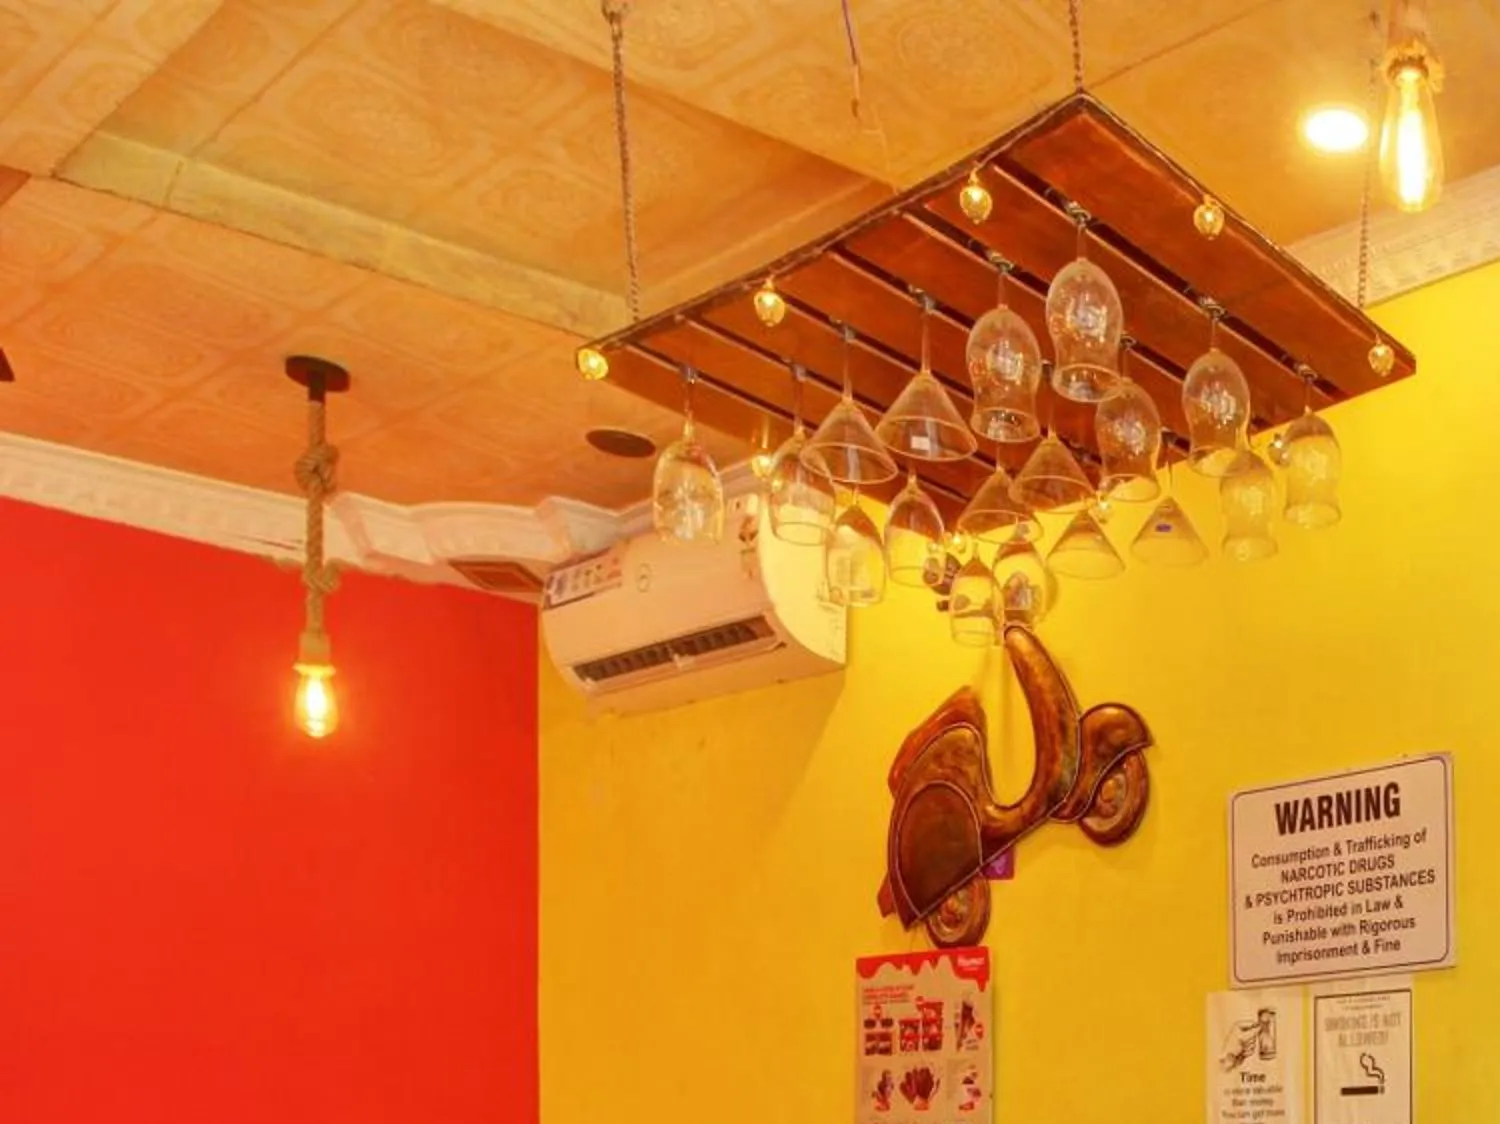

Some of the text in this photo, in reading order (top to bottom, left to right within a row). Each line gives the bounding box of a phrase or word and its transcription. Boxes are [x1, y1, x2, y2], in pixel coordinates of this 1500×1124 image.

[1274, 781, 1401, 837] WARNING
[1251, 827, 1428, 869] Consumption & Trafficking of
[1281, 854, 1396, 884] NARCOTIC DRUGS
[1244, 868, 1436, 910] & PSYCHTROPIC SUBSTANCES
[1273, 895, 1404, 925] is Prohibited in Law &
[1263, 917, 1416, 945] Punishable with Rigorous
[1276, 938, 1401, 966] Imprisonment & Fine
[1239, 1071, 1266, 1084] Time
